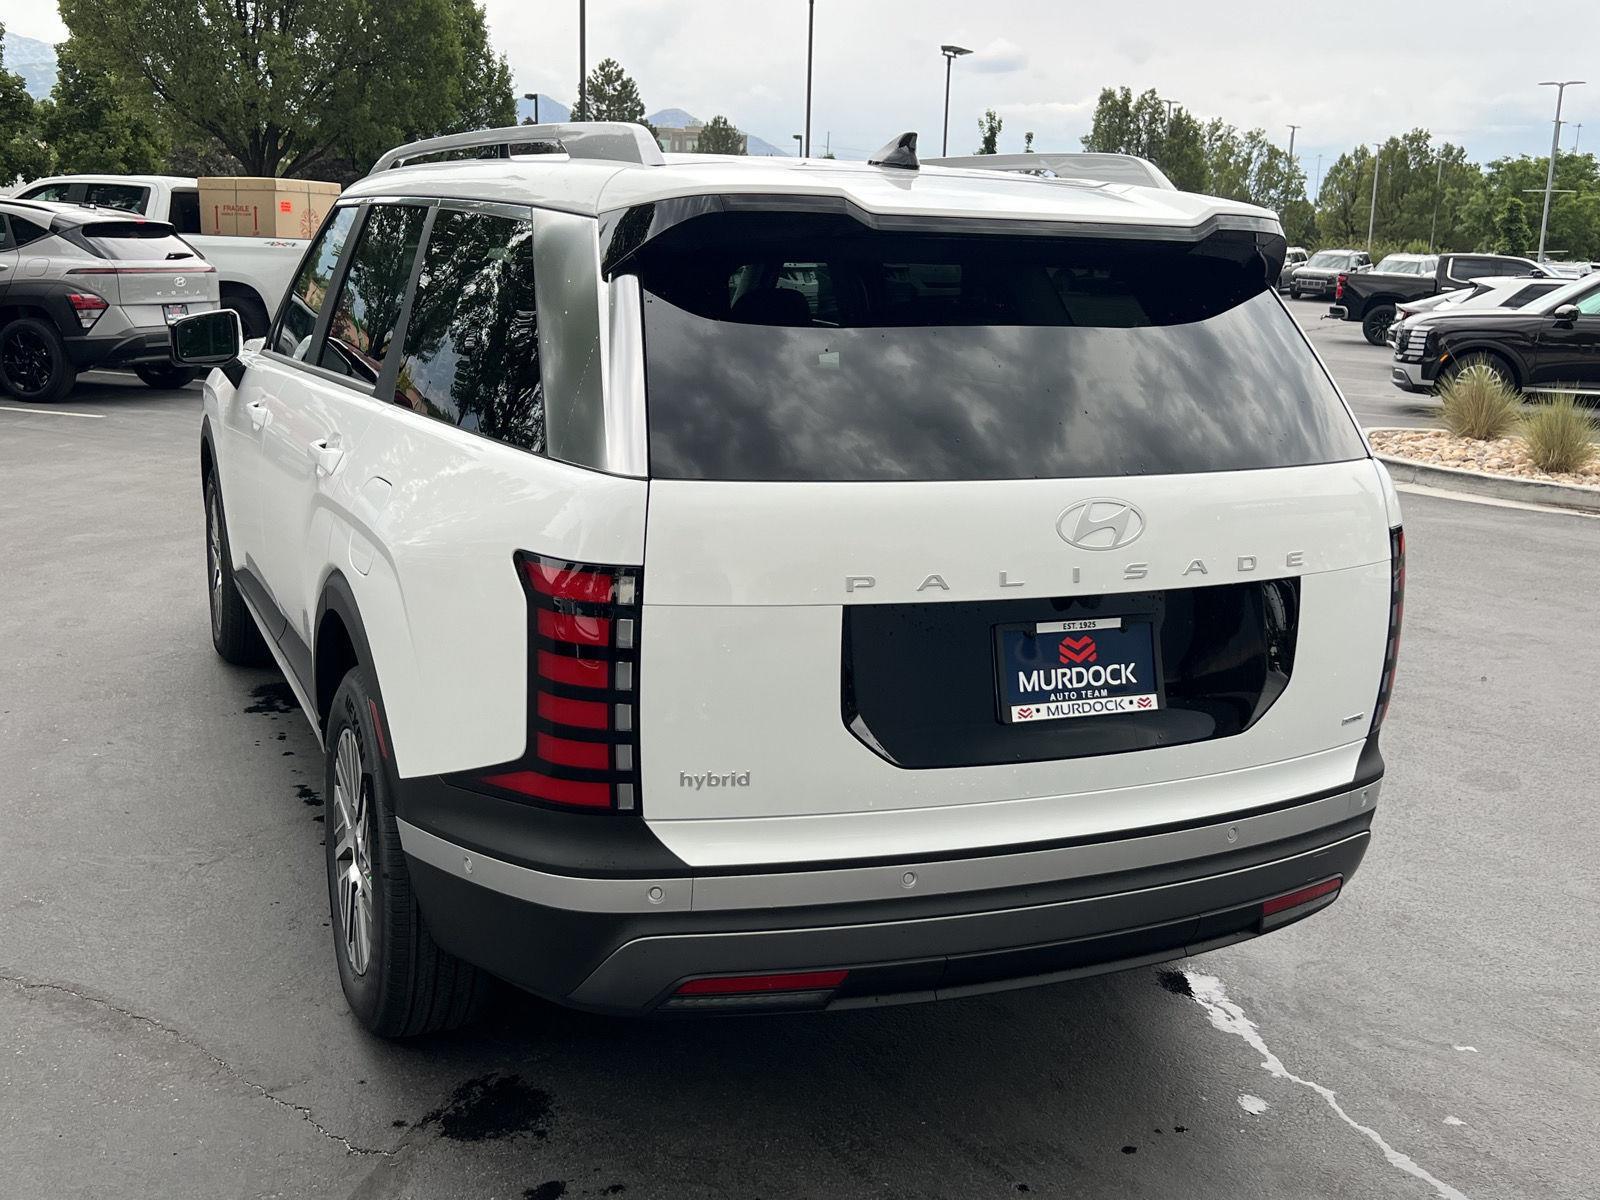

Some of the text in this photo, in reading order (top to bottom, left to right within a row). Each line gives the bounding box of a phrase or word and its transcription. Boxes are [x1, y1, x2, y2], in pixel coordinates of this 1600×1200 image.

[845, 550, 1305, 593] PALISADE
[1063, 621, 1096, 630] EST. 1925
[1018, 662, 1138, 693] MURDOCK
[1049, 688, 1108, 701] AUTO TEAM
[1046, 698, 1126, 717] MURDOCK
[679, 769, 751, 791] hybrid
